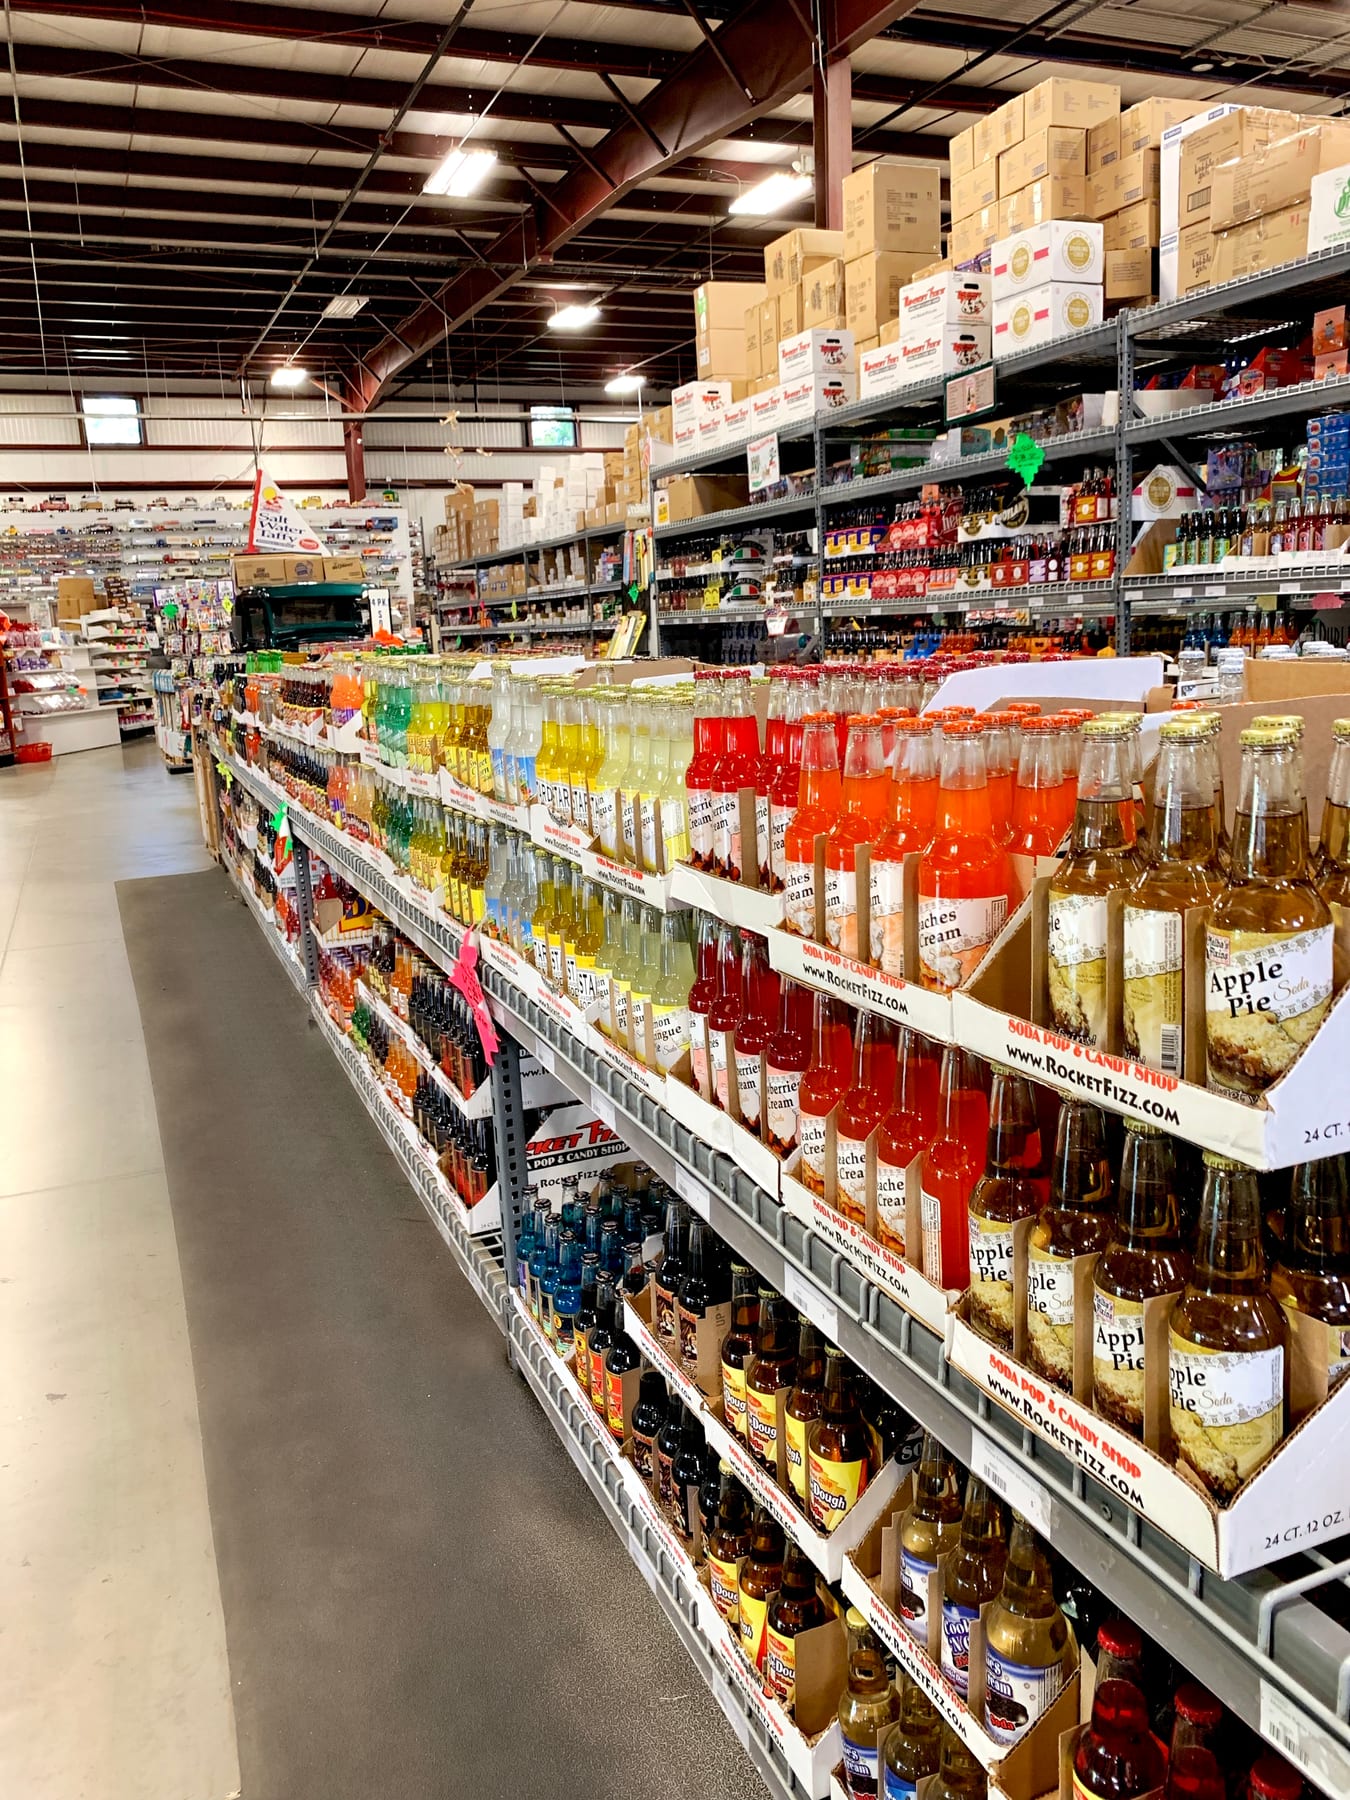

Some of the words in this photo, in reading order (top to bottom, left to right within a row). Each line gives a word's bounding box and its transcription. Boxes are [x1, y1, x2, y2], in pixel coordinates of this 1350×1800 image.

[259, 513, 287, 524] Salt
[260, 521, 305, 534] Water
[259, 529, 298, 542] Taffy
[824, 950, 840, 966] POP
[1210, 960, 1283, 998] Apple
[1228, 994, 1272, 1019] Pie
[1273, 976, 1310, 1001] Soda
[1008, 1018, 1040, 1042] SODA
[1044, 1032, 1070, 1052] POP
[1073, 1044, 1082, 1058] &
[1085, 1048, 1132, 1076] CANDY
[1134, 1064, 1178, 1092] SHOP
[1304, 1128, 1319, 1144] 24
[1324, 1122, 1343, 1138] CT.
[534, 1156, 554, 1169] POP
[558, 1154, 565, 1164] &
[566, 1147, 598, 1162] CANDY
[980, 1266, 1008, 1282] Pie
[1201, 1390, 1233, 1409] Soda
[990, 1354, 1019, 1386] SODA
[1021, 1377, 1046, 1404] POP
[1048, 1399, 1057, 1414] &
[1058, 1407, 1100, 1449] CANDY
[1101, 1440, 1142, 1478] SHOP
[813, 1485, 846, 1510] Dough
[1264, 1533, 1280, 1549] 24
[1284, 1526, 1302, 1541] CT.
[1307, 1520, 1318, 1534] 12
[1323, 1510, 1344, 1528] OZ.
